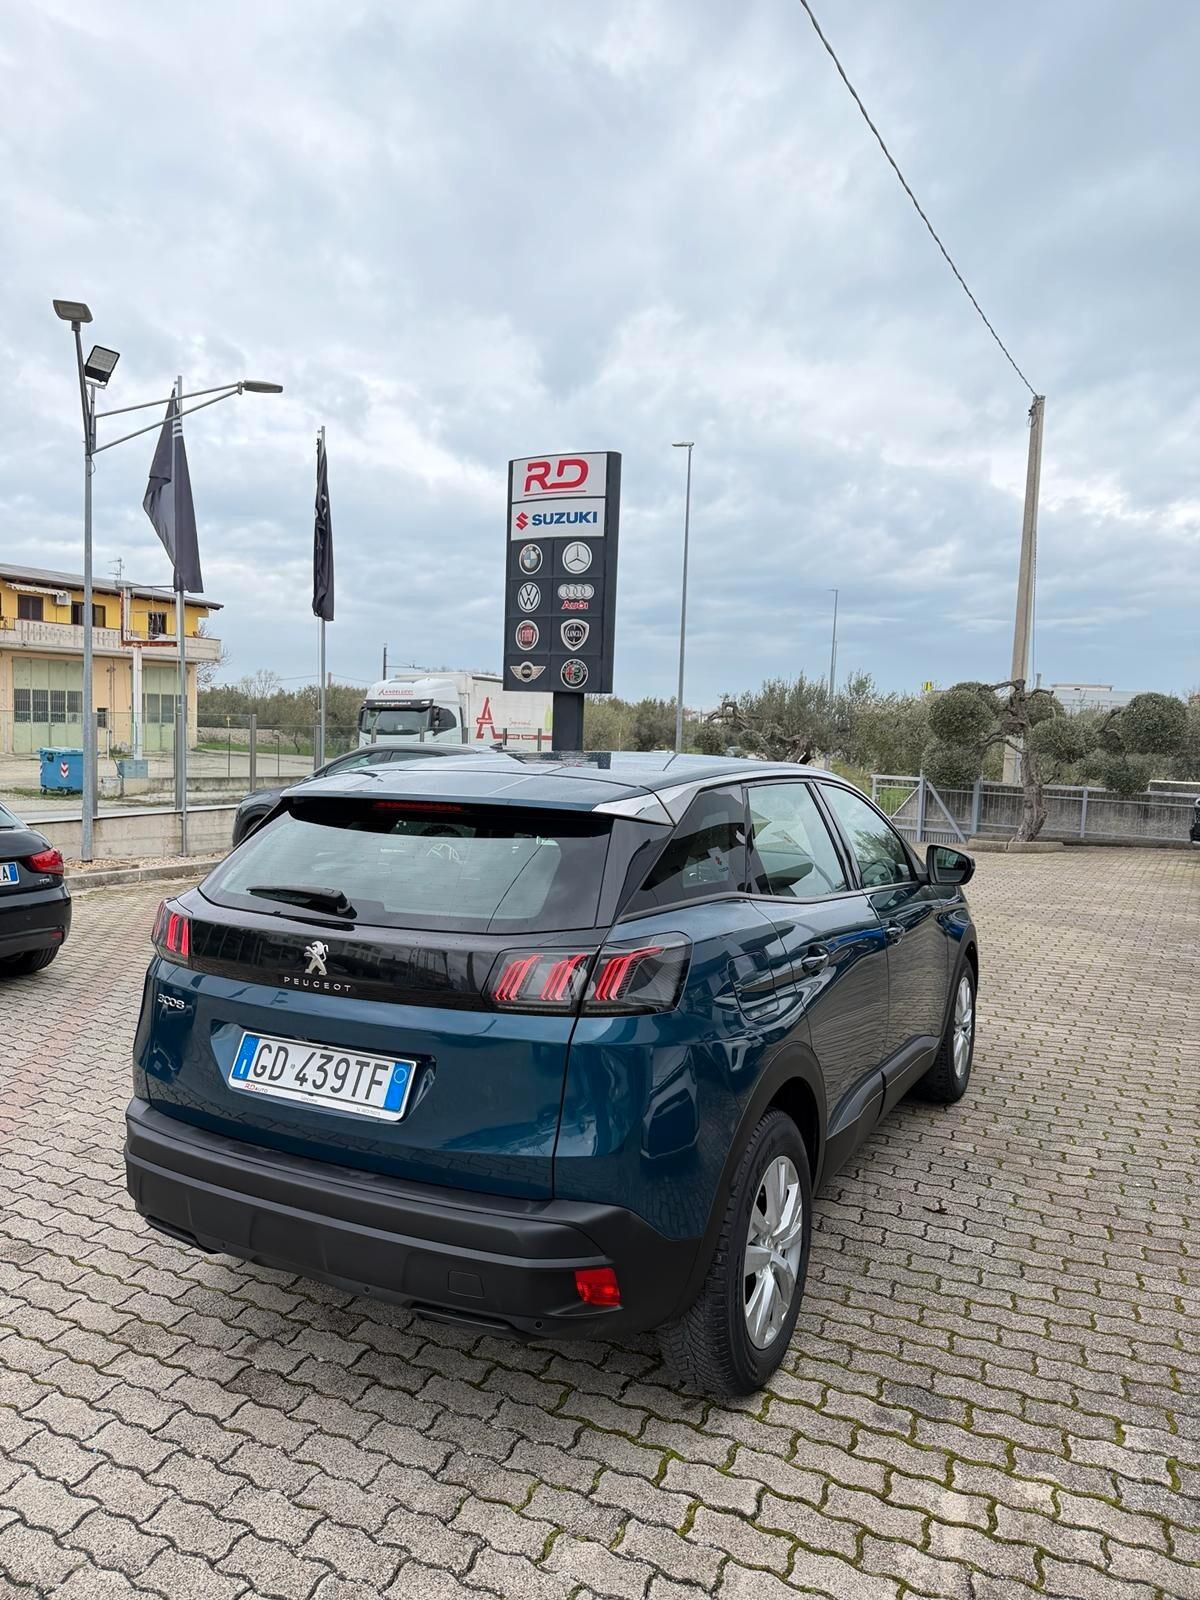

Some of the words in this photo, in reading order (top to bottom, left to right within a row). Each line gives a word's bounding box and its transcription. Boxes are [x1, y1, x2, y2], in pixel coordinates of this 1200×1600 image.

[524, 459, 589, 492] RD
[531, 511, 598, 526] SUZUKI
[561, 600, 589, 610] Audi
[283, 976, 351, 992] PEUGEOT
